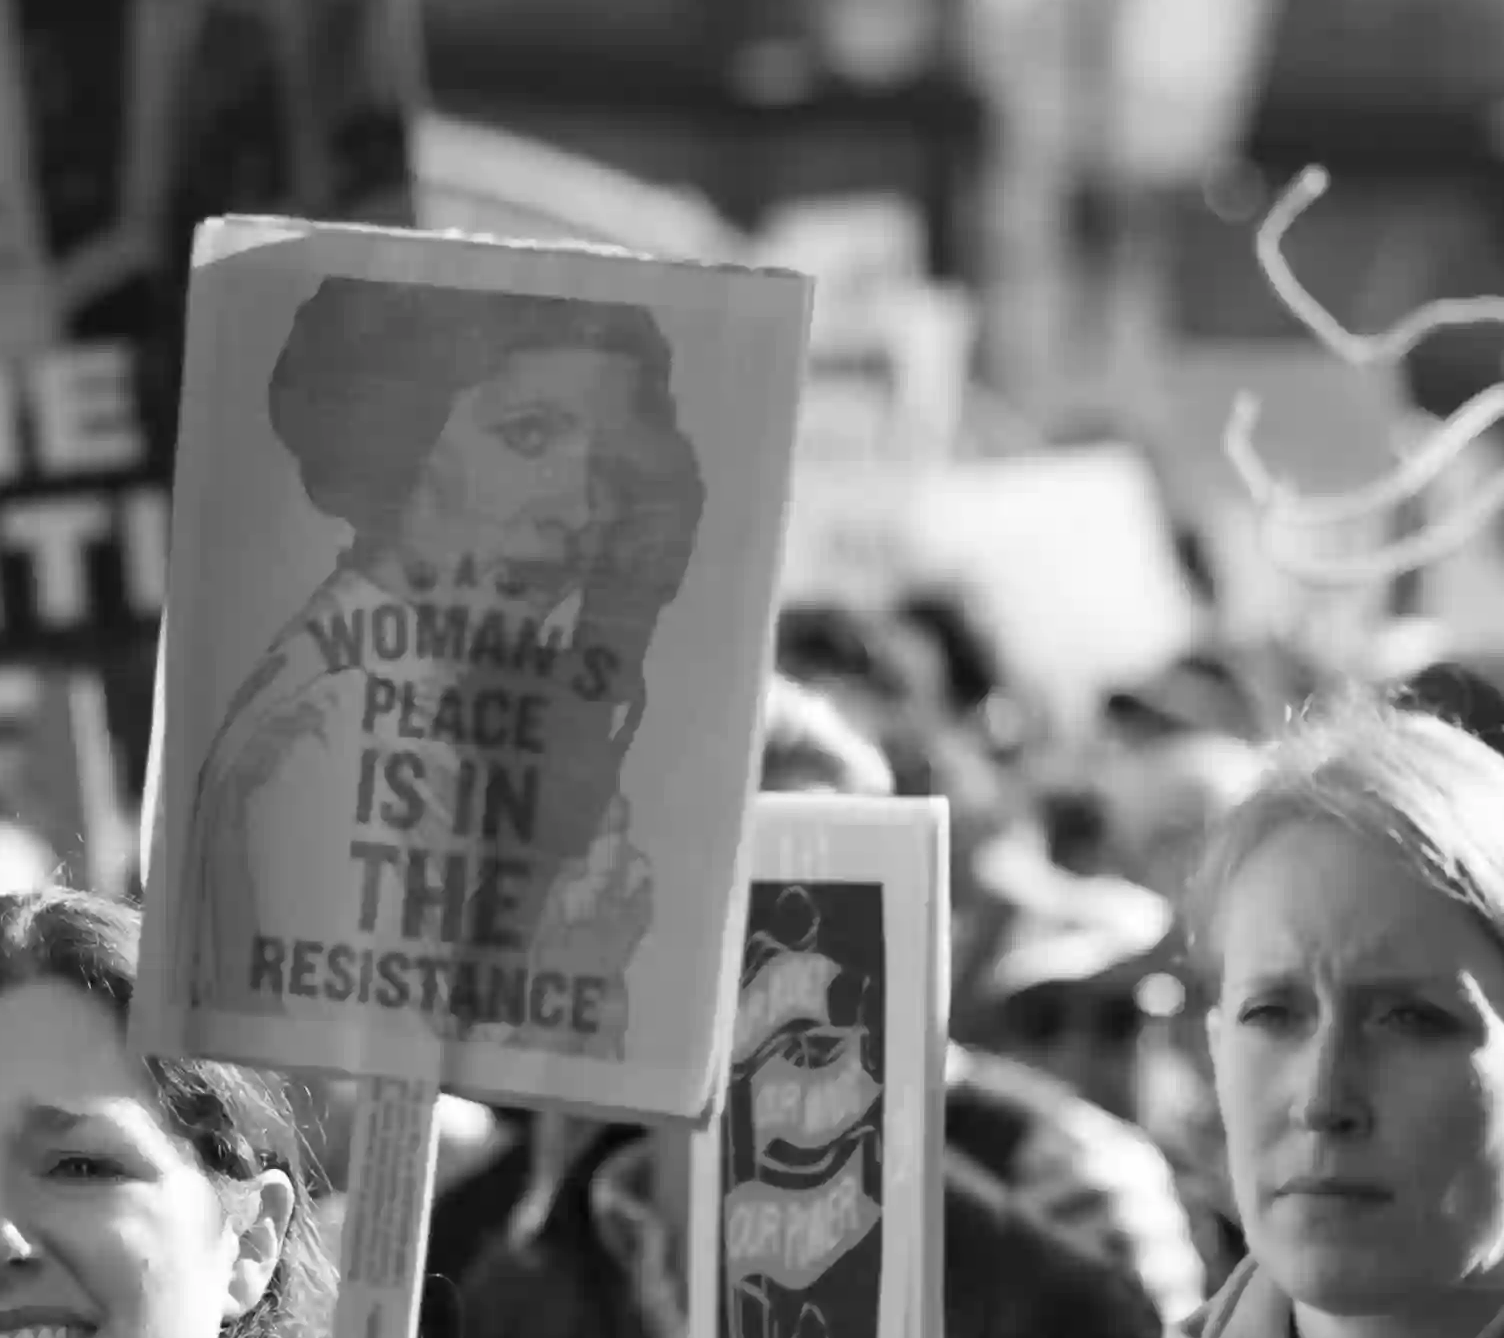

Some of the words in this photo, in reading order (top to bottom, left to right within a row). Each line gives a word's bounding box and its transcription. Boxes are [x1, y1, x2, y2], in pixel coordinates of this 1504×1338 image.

[453, 550, 479, 589] A
[306, 601, 622, 704] WOMAN'S
[361, 676, 548, 753] PLACE
[354, 747, 427, 832] IS
[453, 760, 541, 844] IN
[349, 839, 532, 952] THE
[247, 935, 605, 1035] RESISTANCE
